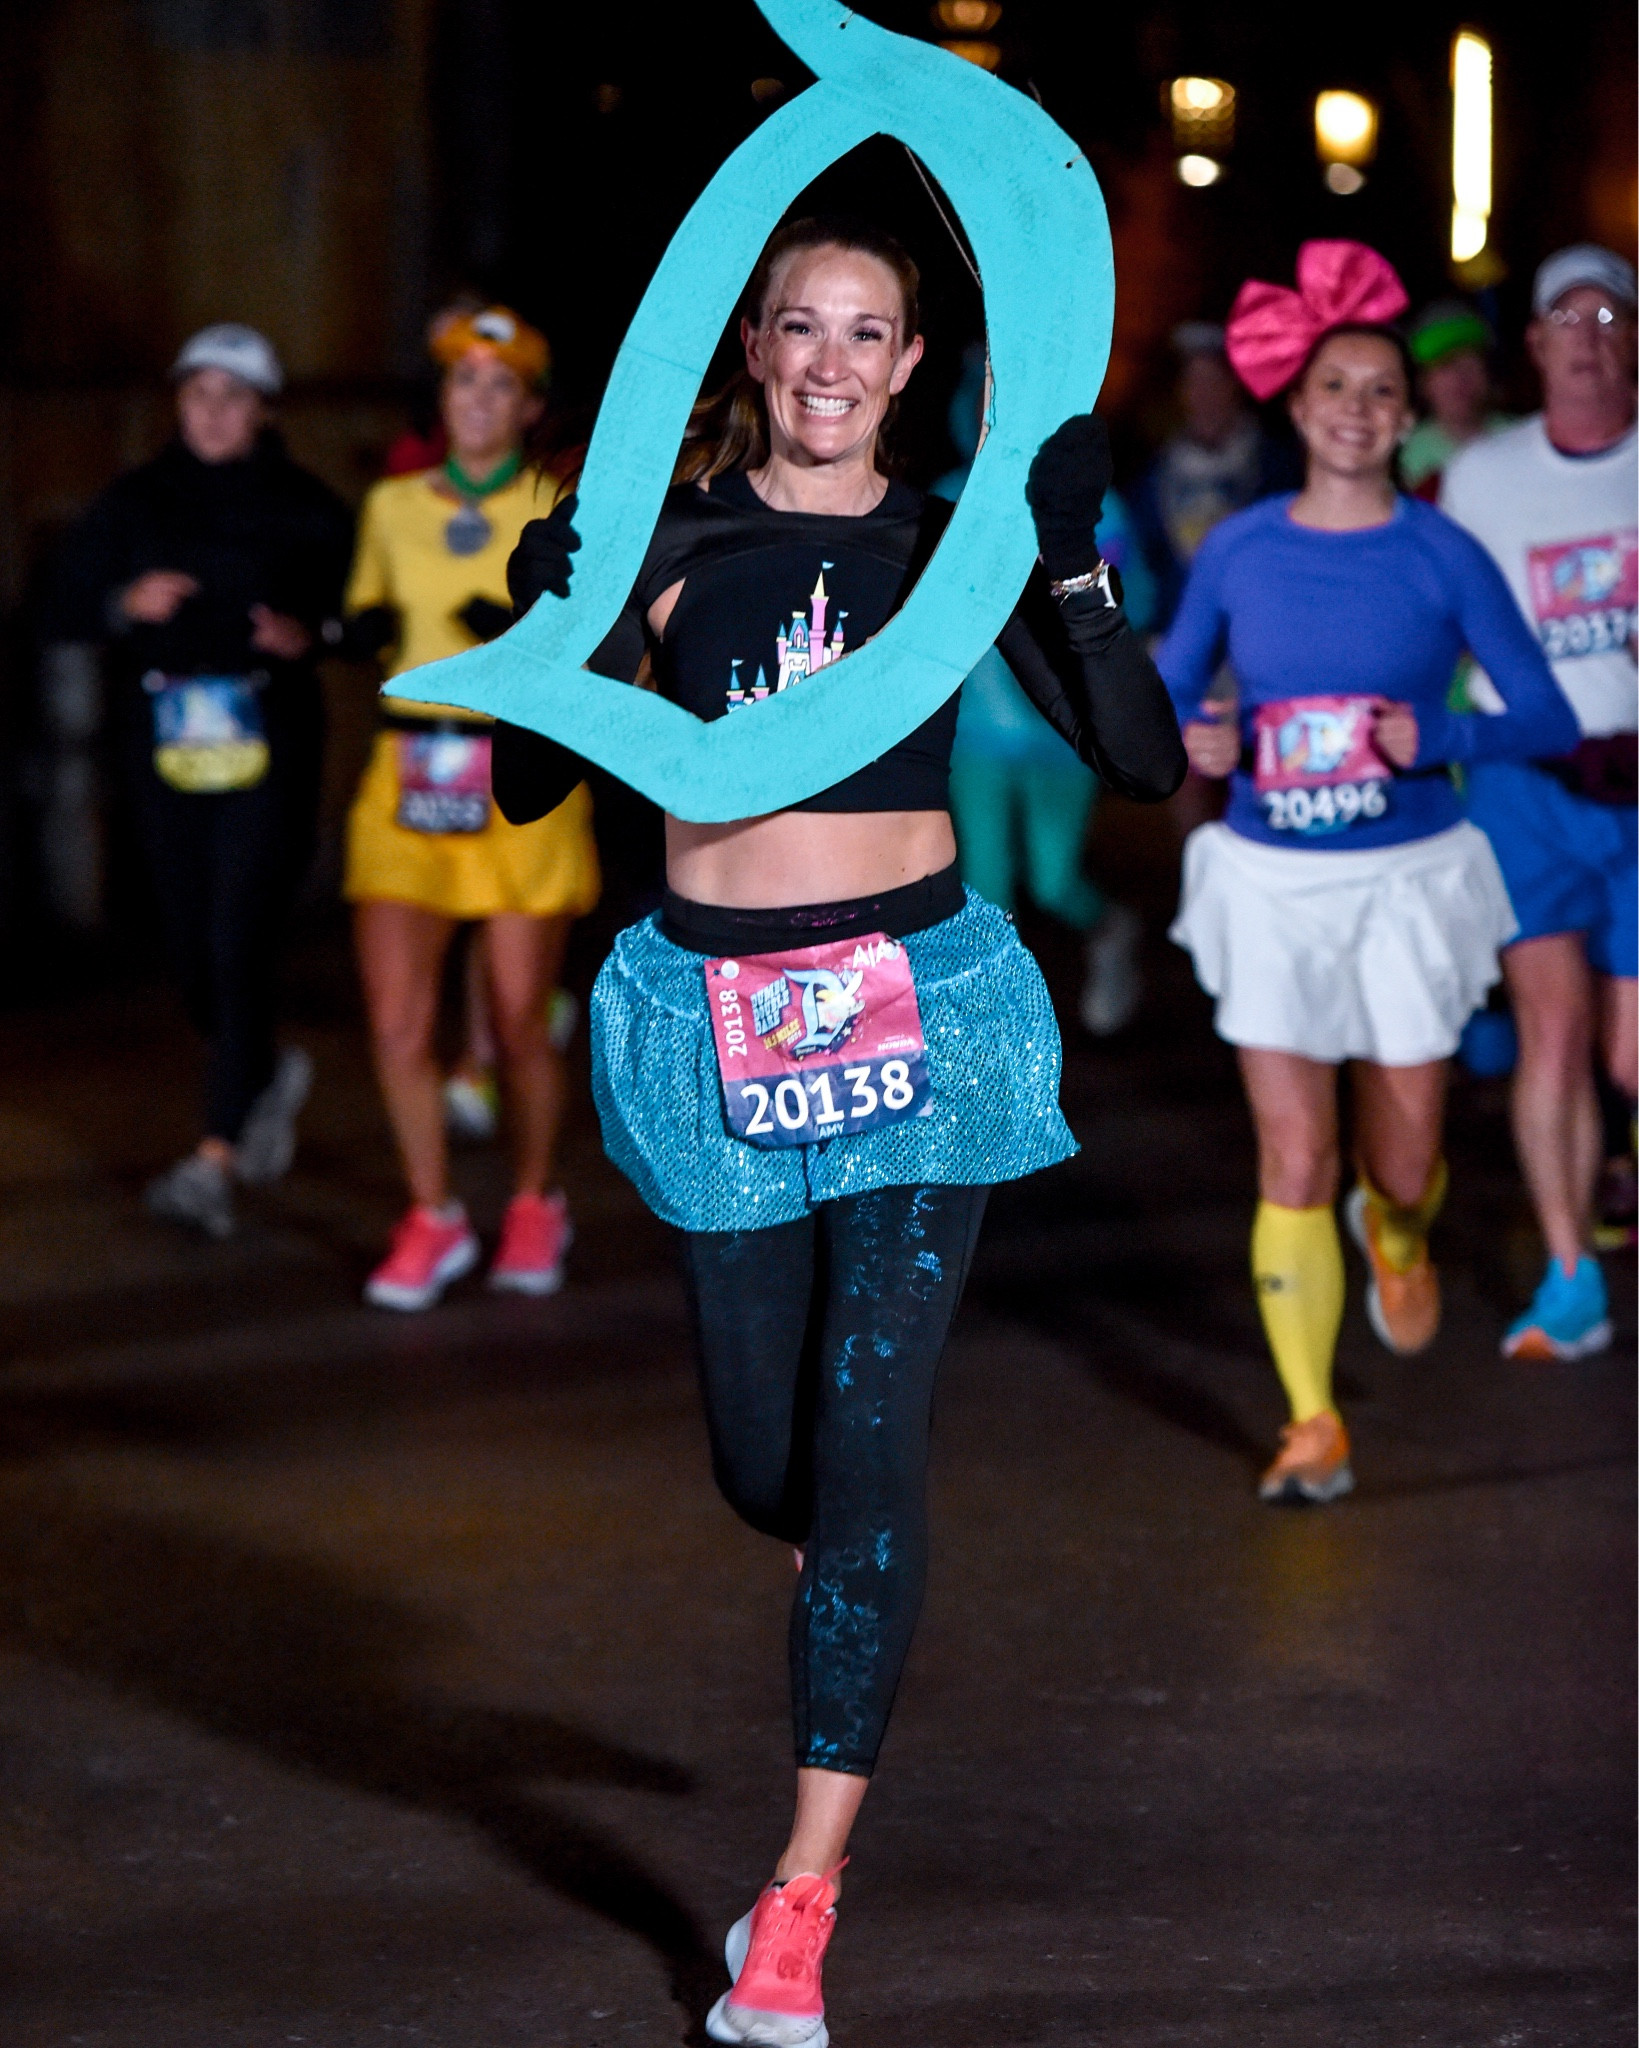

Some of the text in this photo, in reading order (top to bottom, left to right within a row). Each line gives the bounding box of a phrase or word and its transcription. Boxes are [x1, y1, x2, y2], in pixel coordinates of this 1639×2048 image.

[1263, 780, 1387, 830] 20496
[719, 989, 747, 1058] 20138
[754, 1009, 780, 1036] DARE
[877, 1037, 914, 1052] HONDA
[740, 1059, 914, 1136] 20138
[818, 1122, 845, 1140] AMY
